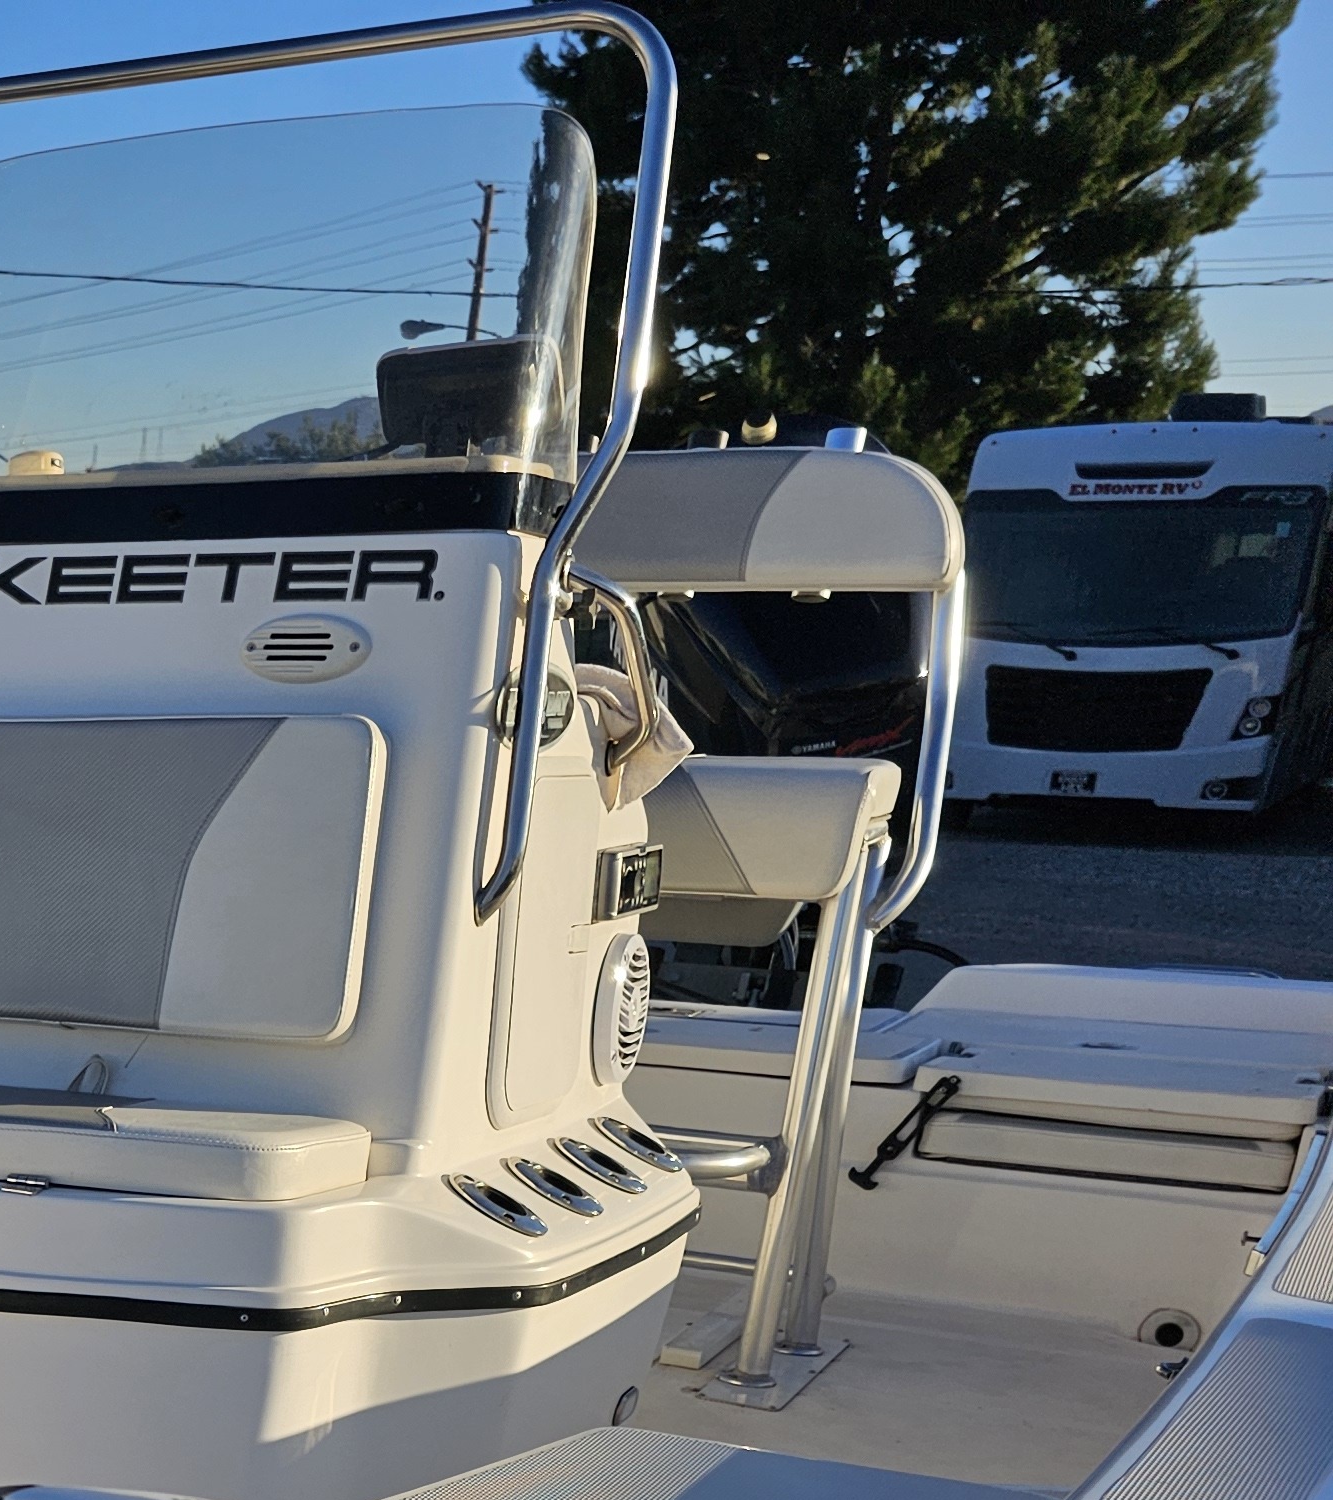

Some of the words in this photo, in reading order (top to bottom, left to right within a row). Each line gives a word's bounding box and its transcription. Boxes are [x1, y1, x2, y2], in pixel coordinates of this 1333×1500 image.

[1068, 483, 1090, 495] EL
[1093, 483, 1157, 495] MONTE
[1160, 482, 1189, 495] RV
[802, 741, 836, 752] YAMAHA
